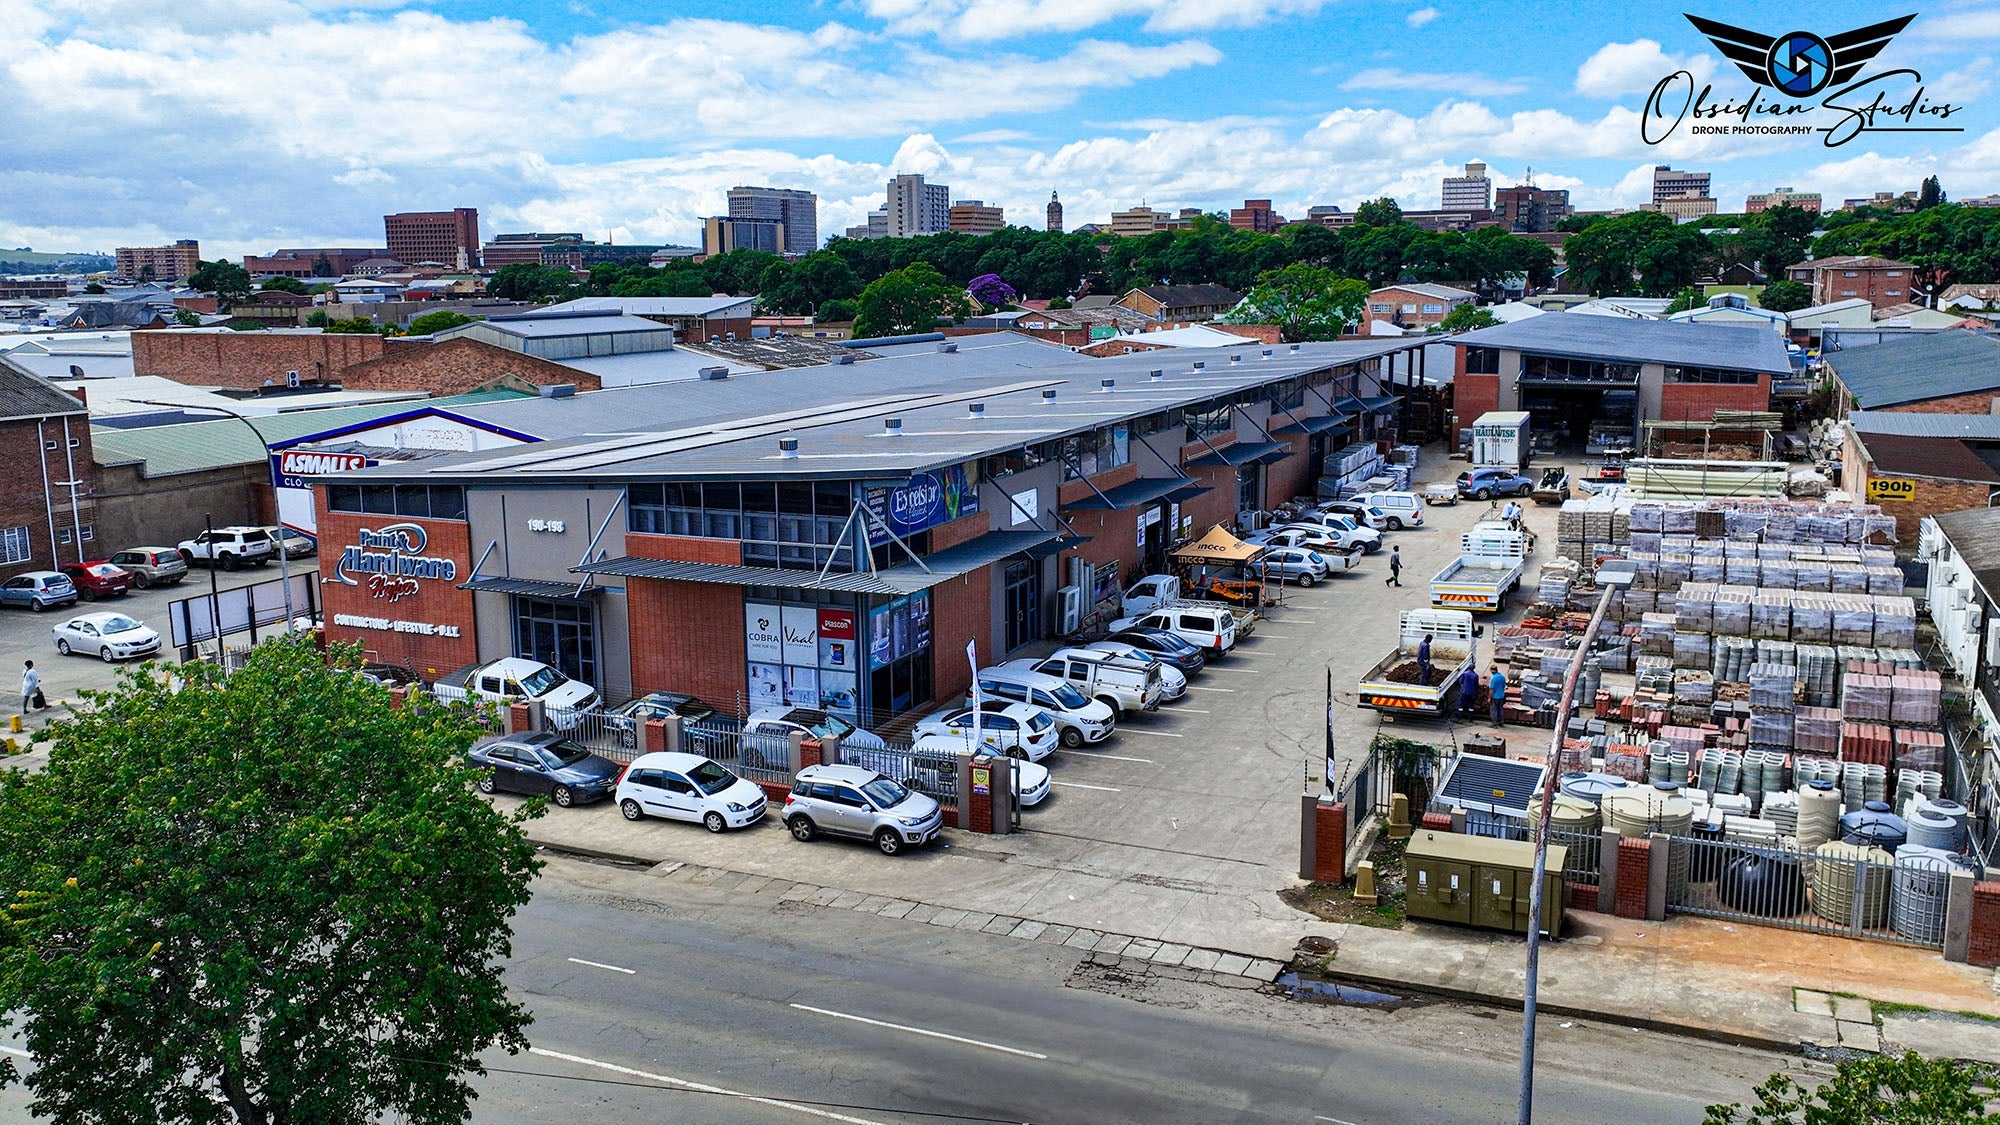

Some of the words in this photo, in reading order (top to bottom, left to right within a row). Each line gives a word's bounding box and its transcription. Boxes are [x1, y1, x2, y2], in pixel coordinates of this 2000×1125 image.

[1870, 481, 1912, 492] 190b
[528, 519, 564, 532] 190-198
[358, 528, 398, 549] Paint
[345, 545, 456, 581] Hardware
[334, 613, 389, 630] CONTRACTORS
[394, 620, 434, 635] LIFESTYLE
[748, 632, 779, 643] COBRA
[784, 626, 816, 644] Vaal
